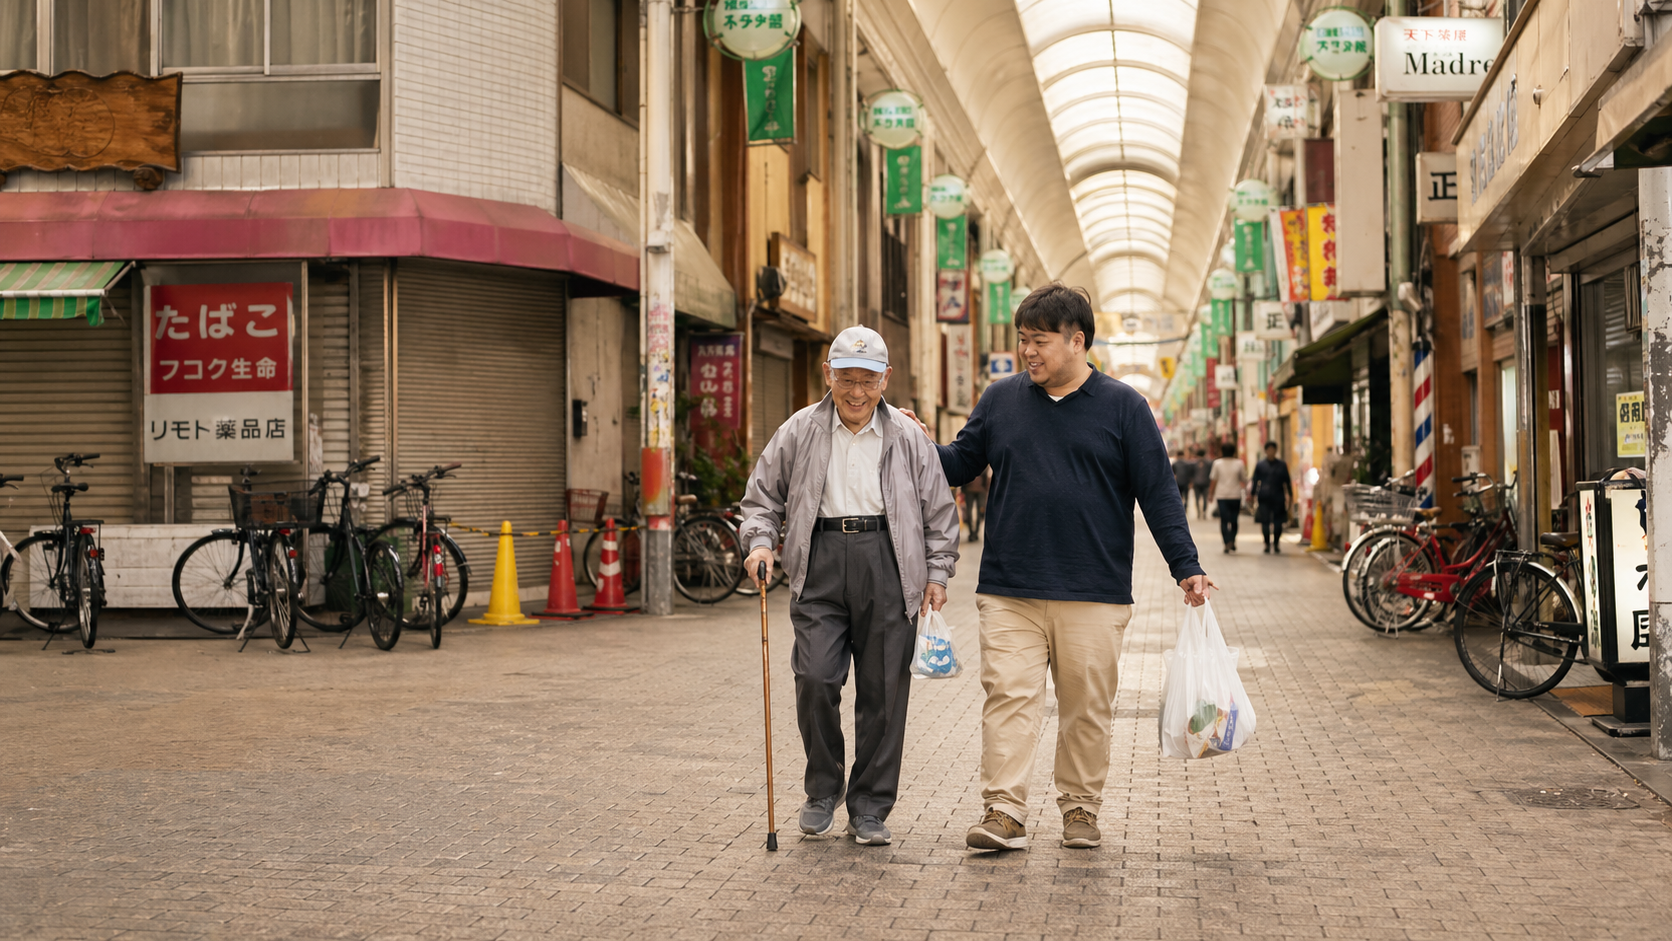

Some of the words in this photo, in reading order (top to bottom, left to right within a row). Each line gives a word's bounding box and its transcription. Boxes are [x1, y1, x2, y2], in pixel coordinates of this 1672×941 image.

[1403, 52, 1495, 76] Madre
[1428, 171, 1457, 201] 正
[155, 302, 278, 340] たばこ
[159, 357, 277, 381] フコク生命
[151, 418, 286, 441] リモト薬品店
